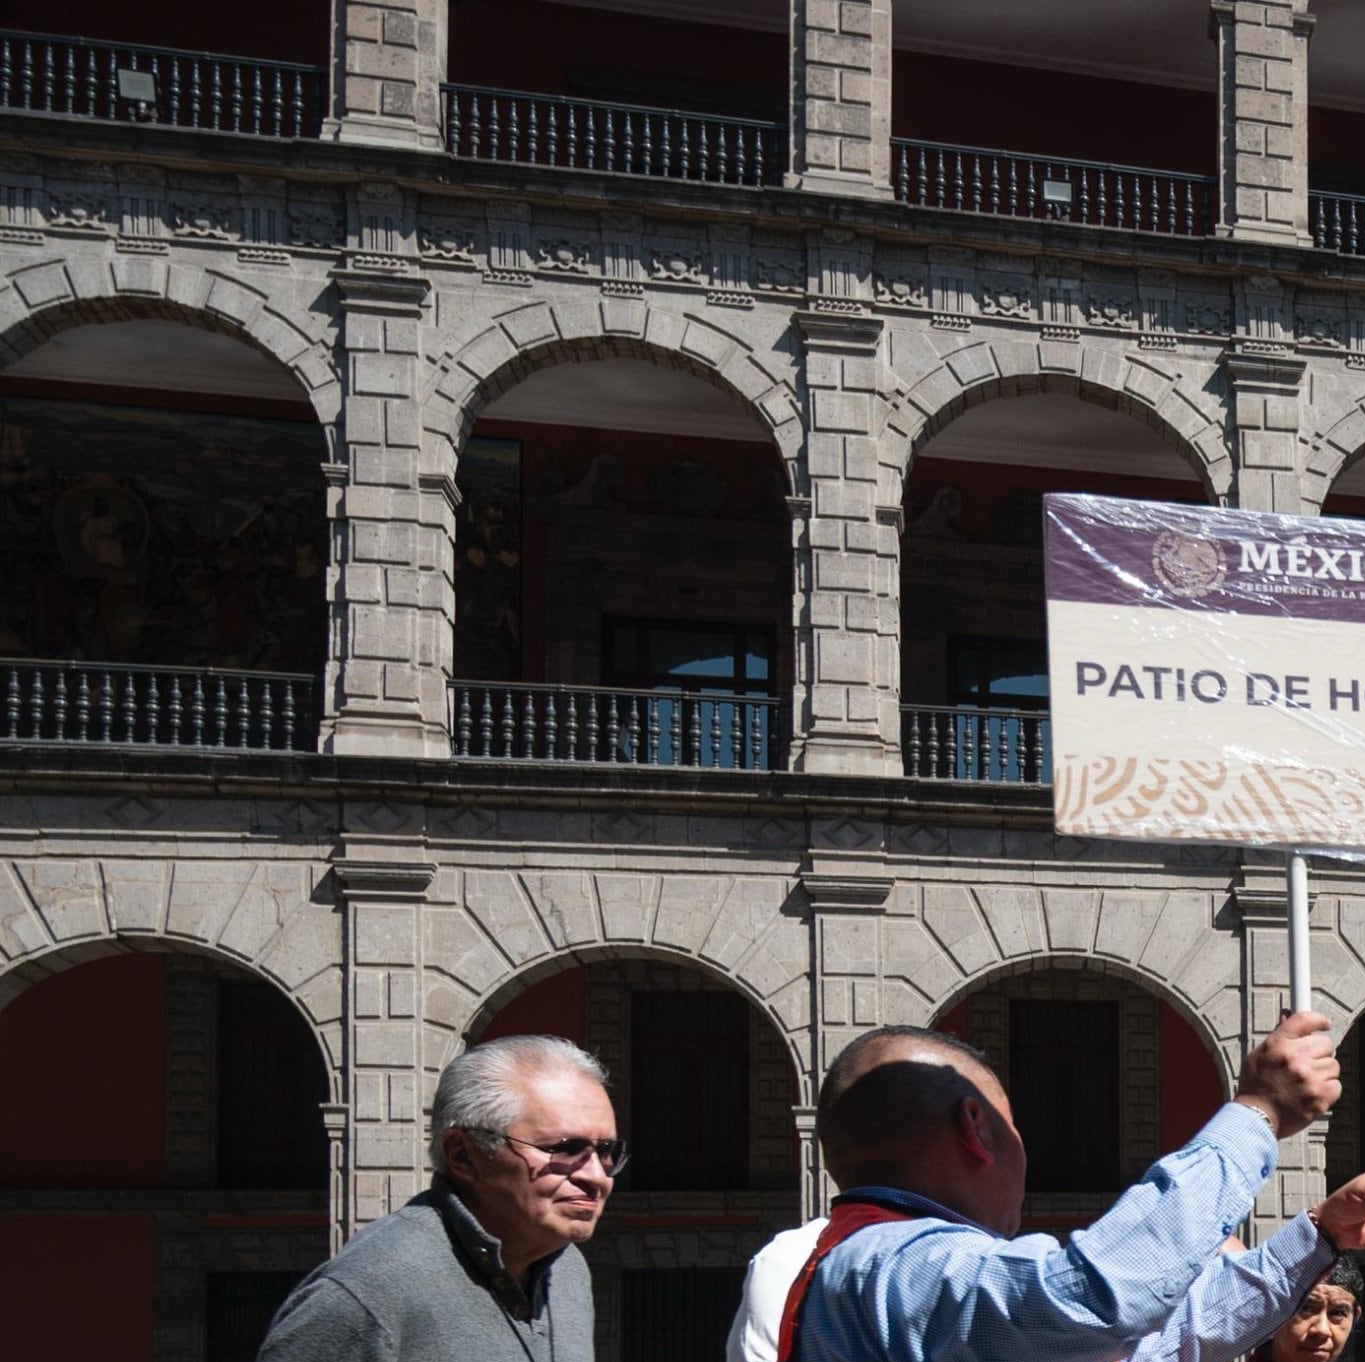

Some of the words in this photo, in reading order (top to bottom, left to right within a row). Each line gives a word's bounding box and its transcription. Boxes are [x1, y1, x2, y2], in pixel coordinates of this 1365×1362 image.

[1238, 582, 1319, 597] PRESIDENCIA
[1322, 588, 1338, 598] DE
[1341, 590, 1357, 600] LA
[1075, 661, 1227, 704] PATIO
[1246, 673, 1311, 710] DE
